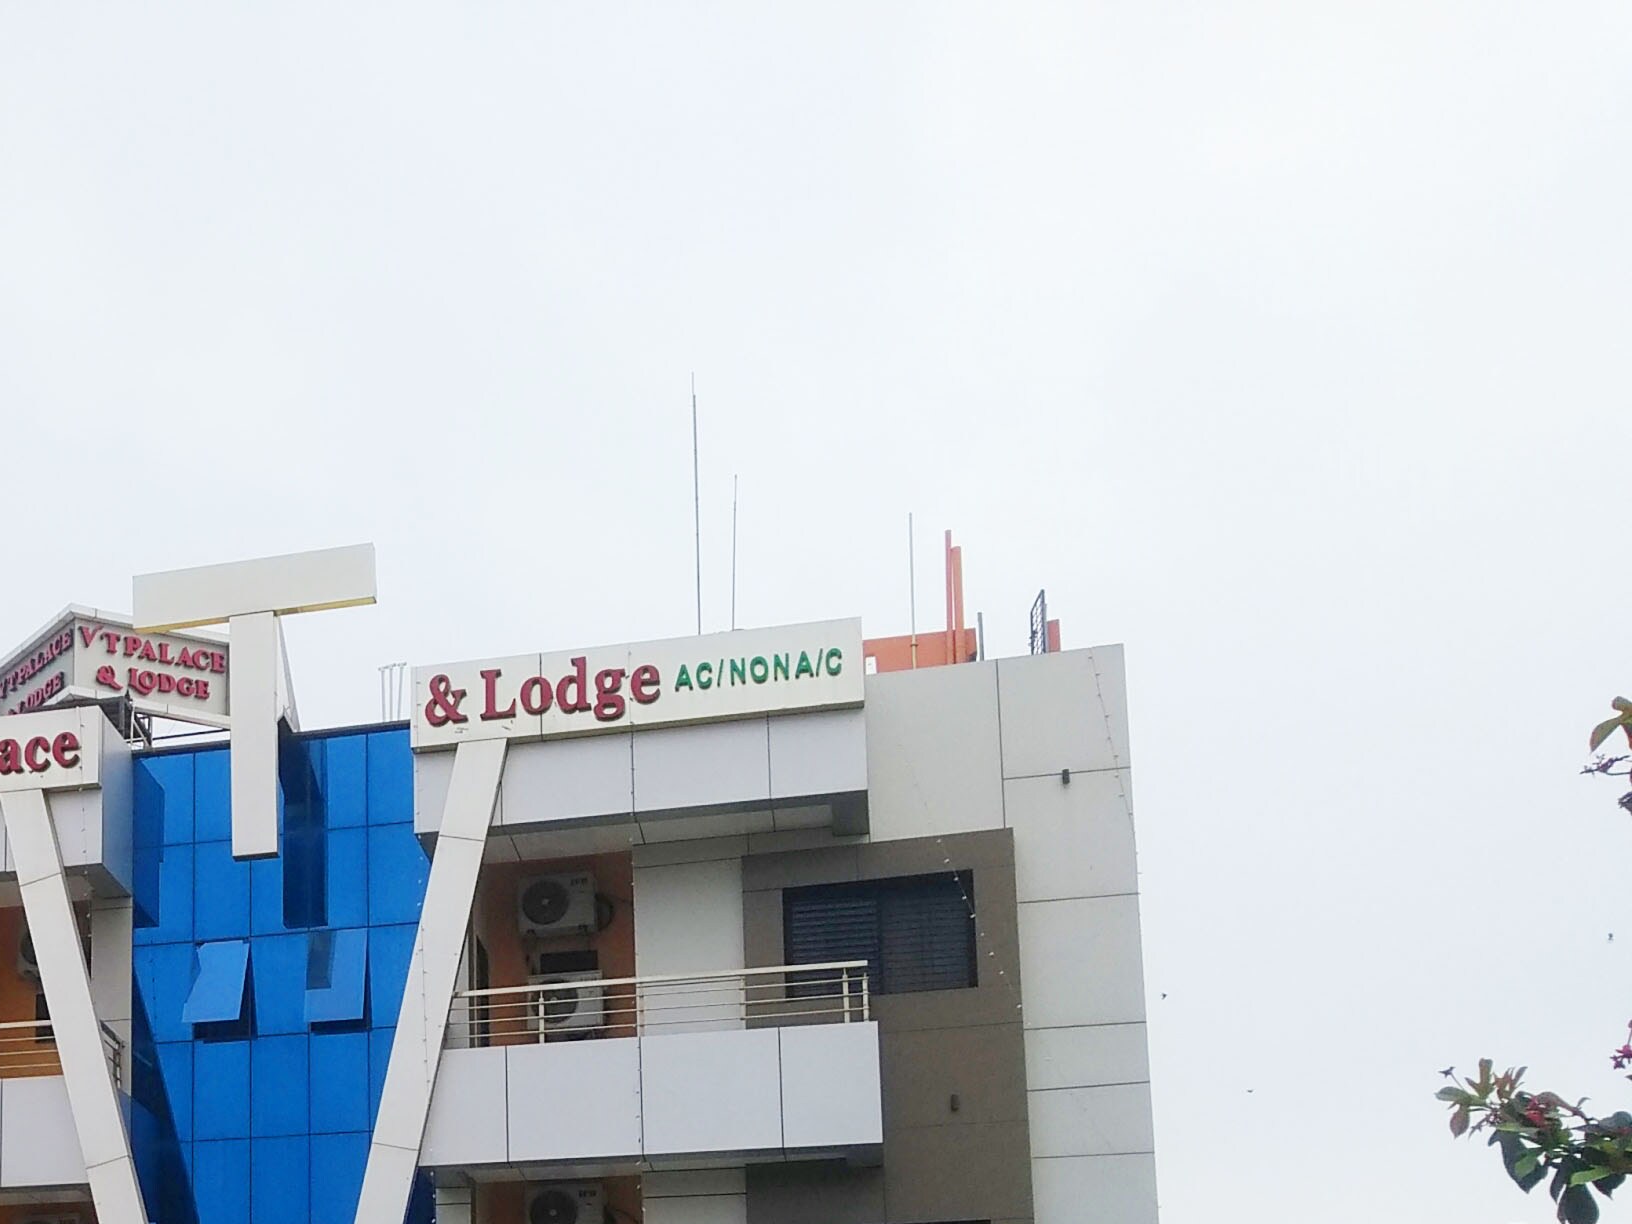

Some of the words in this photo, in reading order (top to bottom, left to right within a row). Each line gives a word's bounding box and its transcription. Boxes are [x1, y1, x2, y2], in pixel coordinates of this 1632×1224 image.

[96, 665, 123, 691] &
[128, 667, 210, 700] LODGE
[424, 674, 467, 728] &
[480, 656, 661, 722] Lodge
